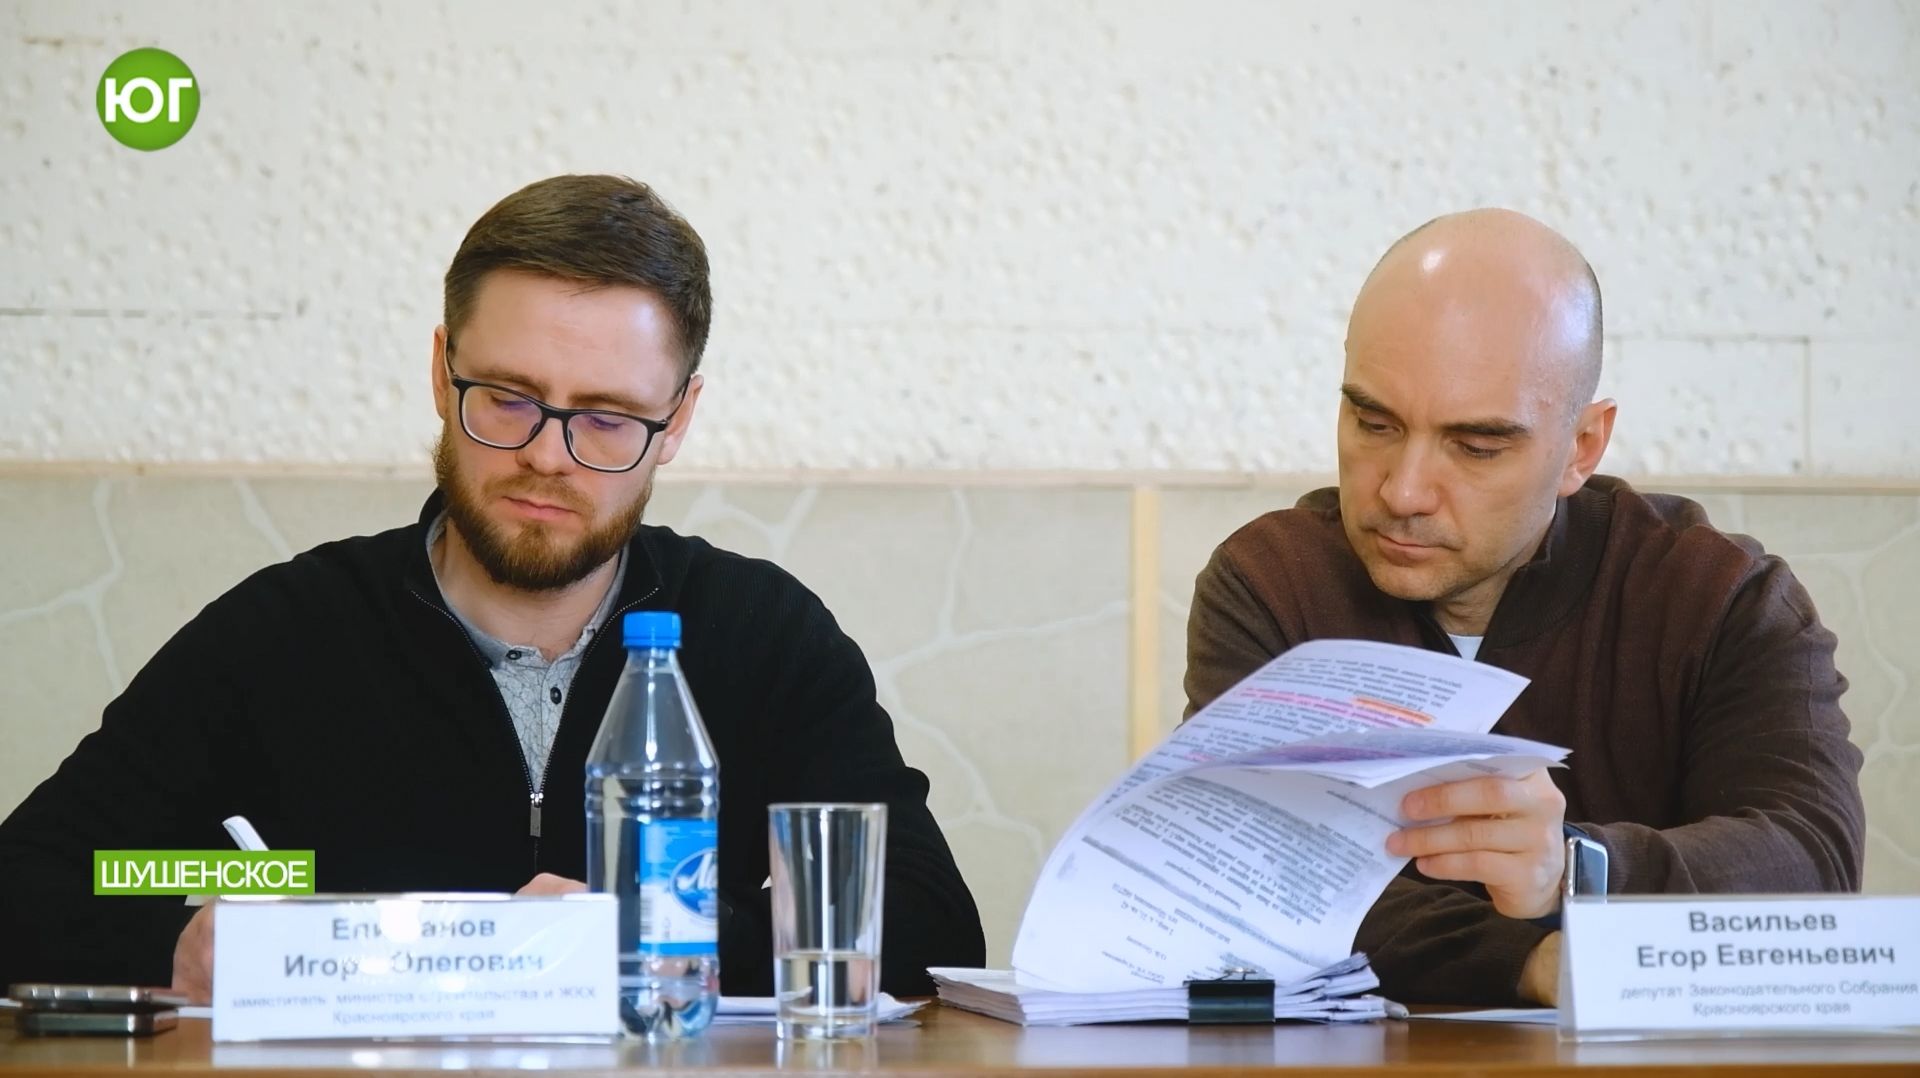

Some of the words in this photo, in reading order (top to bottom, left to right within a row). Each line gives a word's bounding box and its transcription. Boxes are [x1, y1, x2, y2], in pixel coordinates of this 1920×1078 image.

[331, 916, 497, 941] Епианов
[1688, 910, 1838, 933] Васильев
[284, 954, 382, 981] Игор
[391, 950, 545, 974] Олегович
[1637, 946, 1707, 971] Егор
[1717, 943, 1896, 967] Евгеньевич
[336, 992, 415, 1006] министра
[1621, 985, 1683, 1000] депутат
[1688, 982, 1835, 998] Законодательного
[1839, 979, 1918, 996] Собрания
[332, 1010, 455, 1027] Красноярского
[1692, 1001, 1812, 1017] Красноярского
[1815, 1001, 1851, 1015] края
